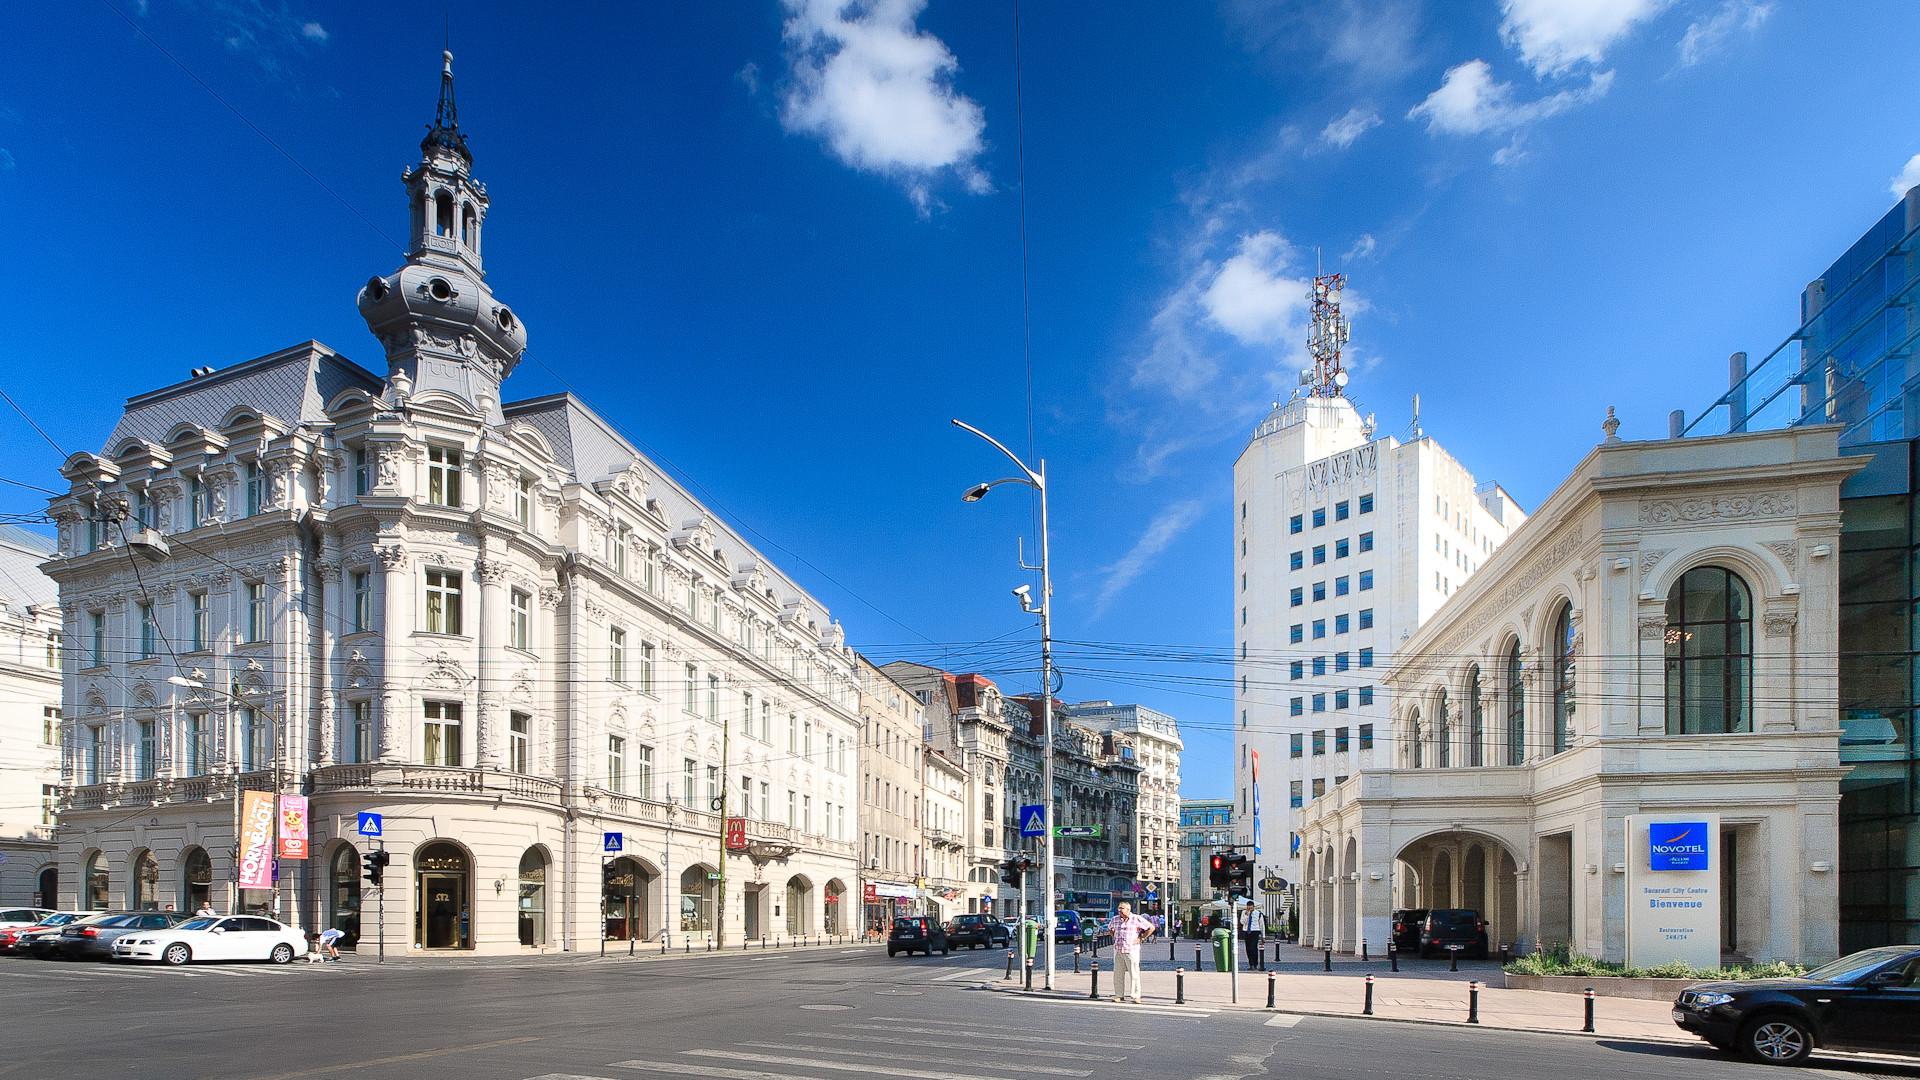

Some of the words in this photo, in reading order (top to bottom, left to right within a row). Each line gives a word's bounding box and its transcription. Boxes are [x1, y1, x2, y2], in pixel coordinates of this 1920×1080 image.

[239, 801, 274, 885] HORNBACH
[1652, 844, 1705, 853] NOVOTEL
[1264, 878, 1281, 890] RC
[1672, 887, 1685, 895] City
[1650, 899, 1703, 909] Bienvenue
